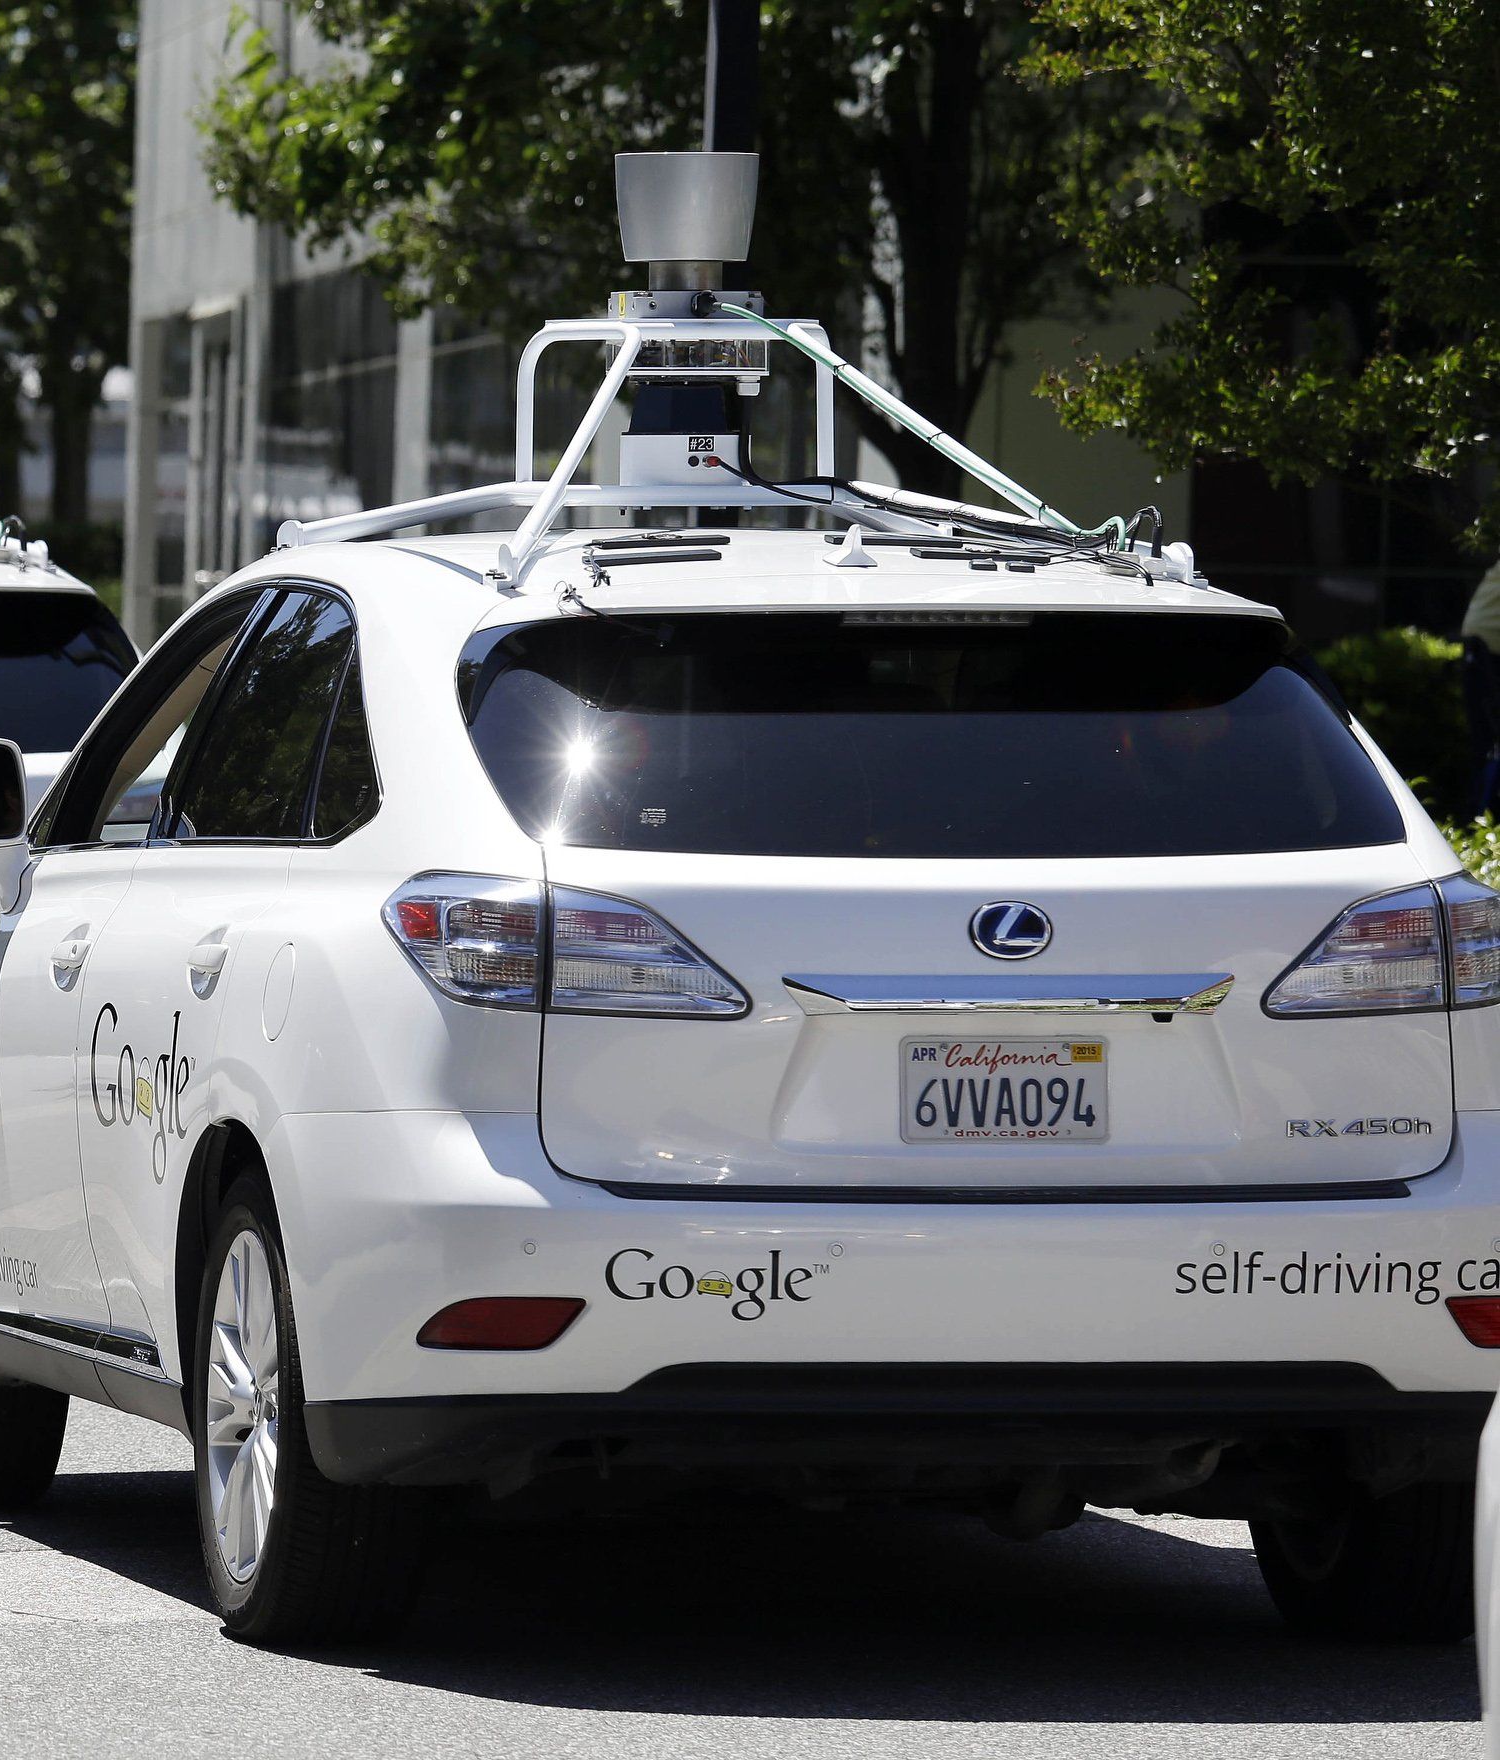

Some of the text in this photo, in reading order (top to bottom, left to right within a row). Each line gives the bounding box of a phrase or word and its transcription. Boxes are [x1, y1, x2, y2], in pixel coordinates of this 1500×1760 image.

[690, 438, 713, 450] #23
[911, 1043, 1097, 1075] APR California 2015
[915, 1077, 1096, 1128] 6VVA094
[954, 1129, 1060, 1139] dmv.ca.gov
[23, 1260, 39, 1288] car
[1175, 1251, 1500, 1306] self-driving ca
